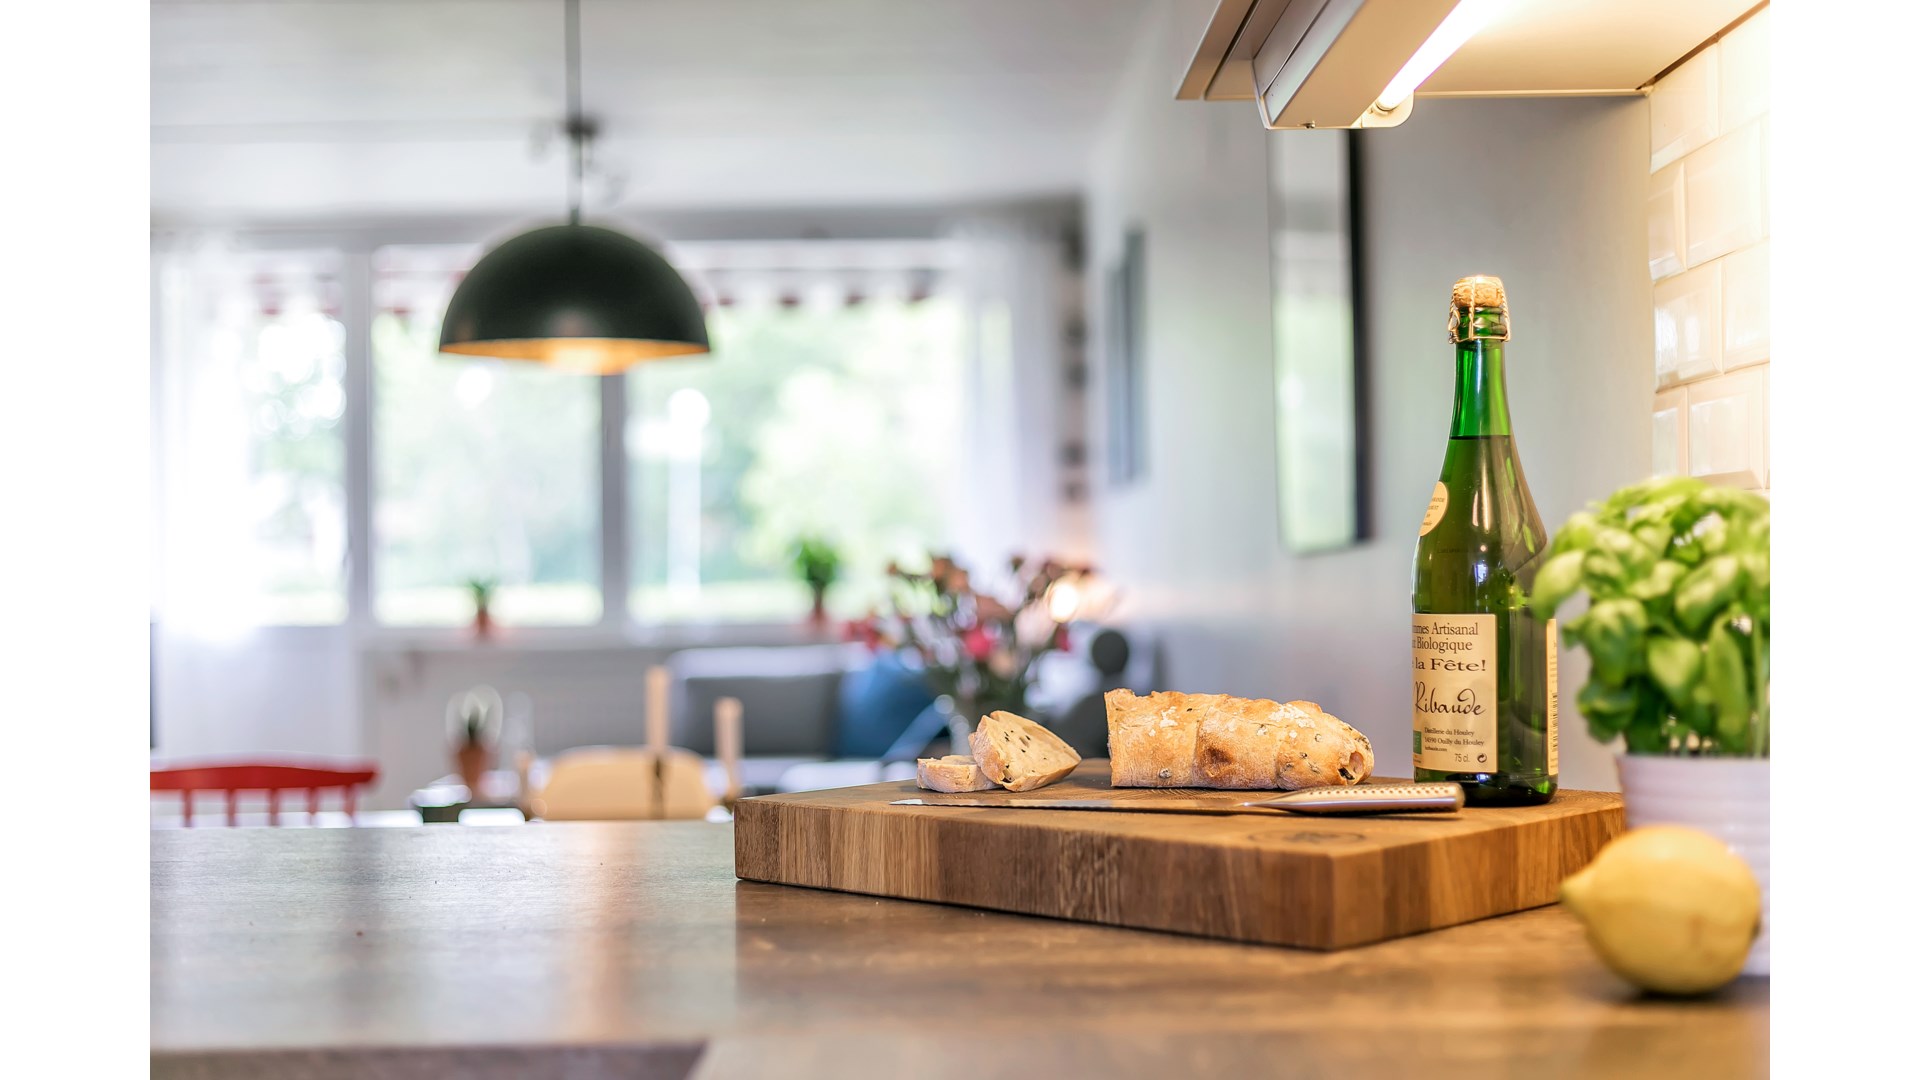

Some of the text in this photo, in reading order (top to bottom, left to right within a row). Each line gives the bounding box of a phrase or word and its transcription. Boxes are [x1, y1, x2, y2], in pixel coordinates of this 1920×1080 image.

[1431, 621, 1478, 635] Artisanal
[1417, 636, 1473, 654] Biologique
[1415, 656, 1426, 670] la
[1430, 658, 1486, 671] Fête!
[1414, 680, 1486, 715] Ribaude
[1453, 729, 1474, 737] Houley
[1455, 753, 1462, 762] 75
